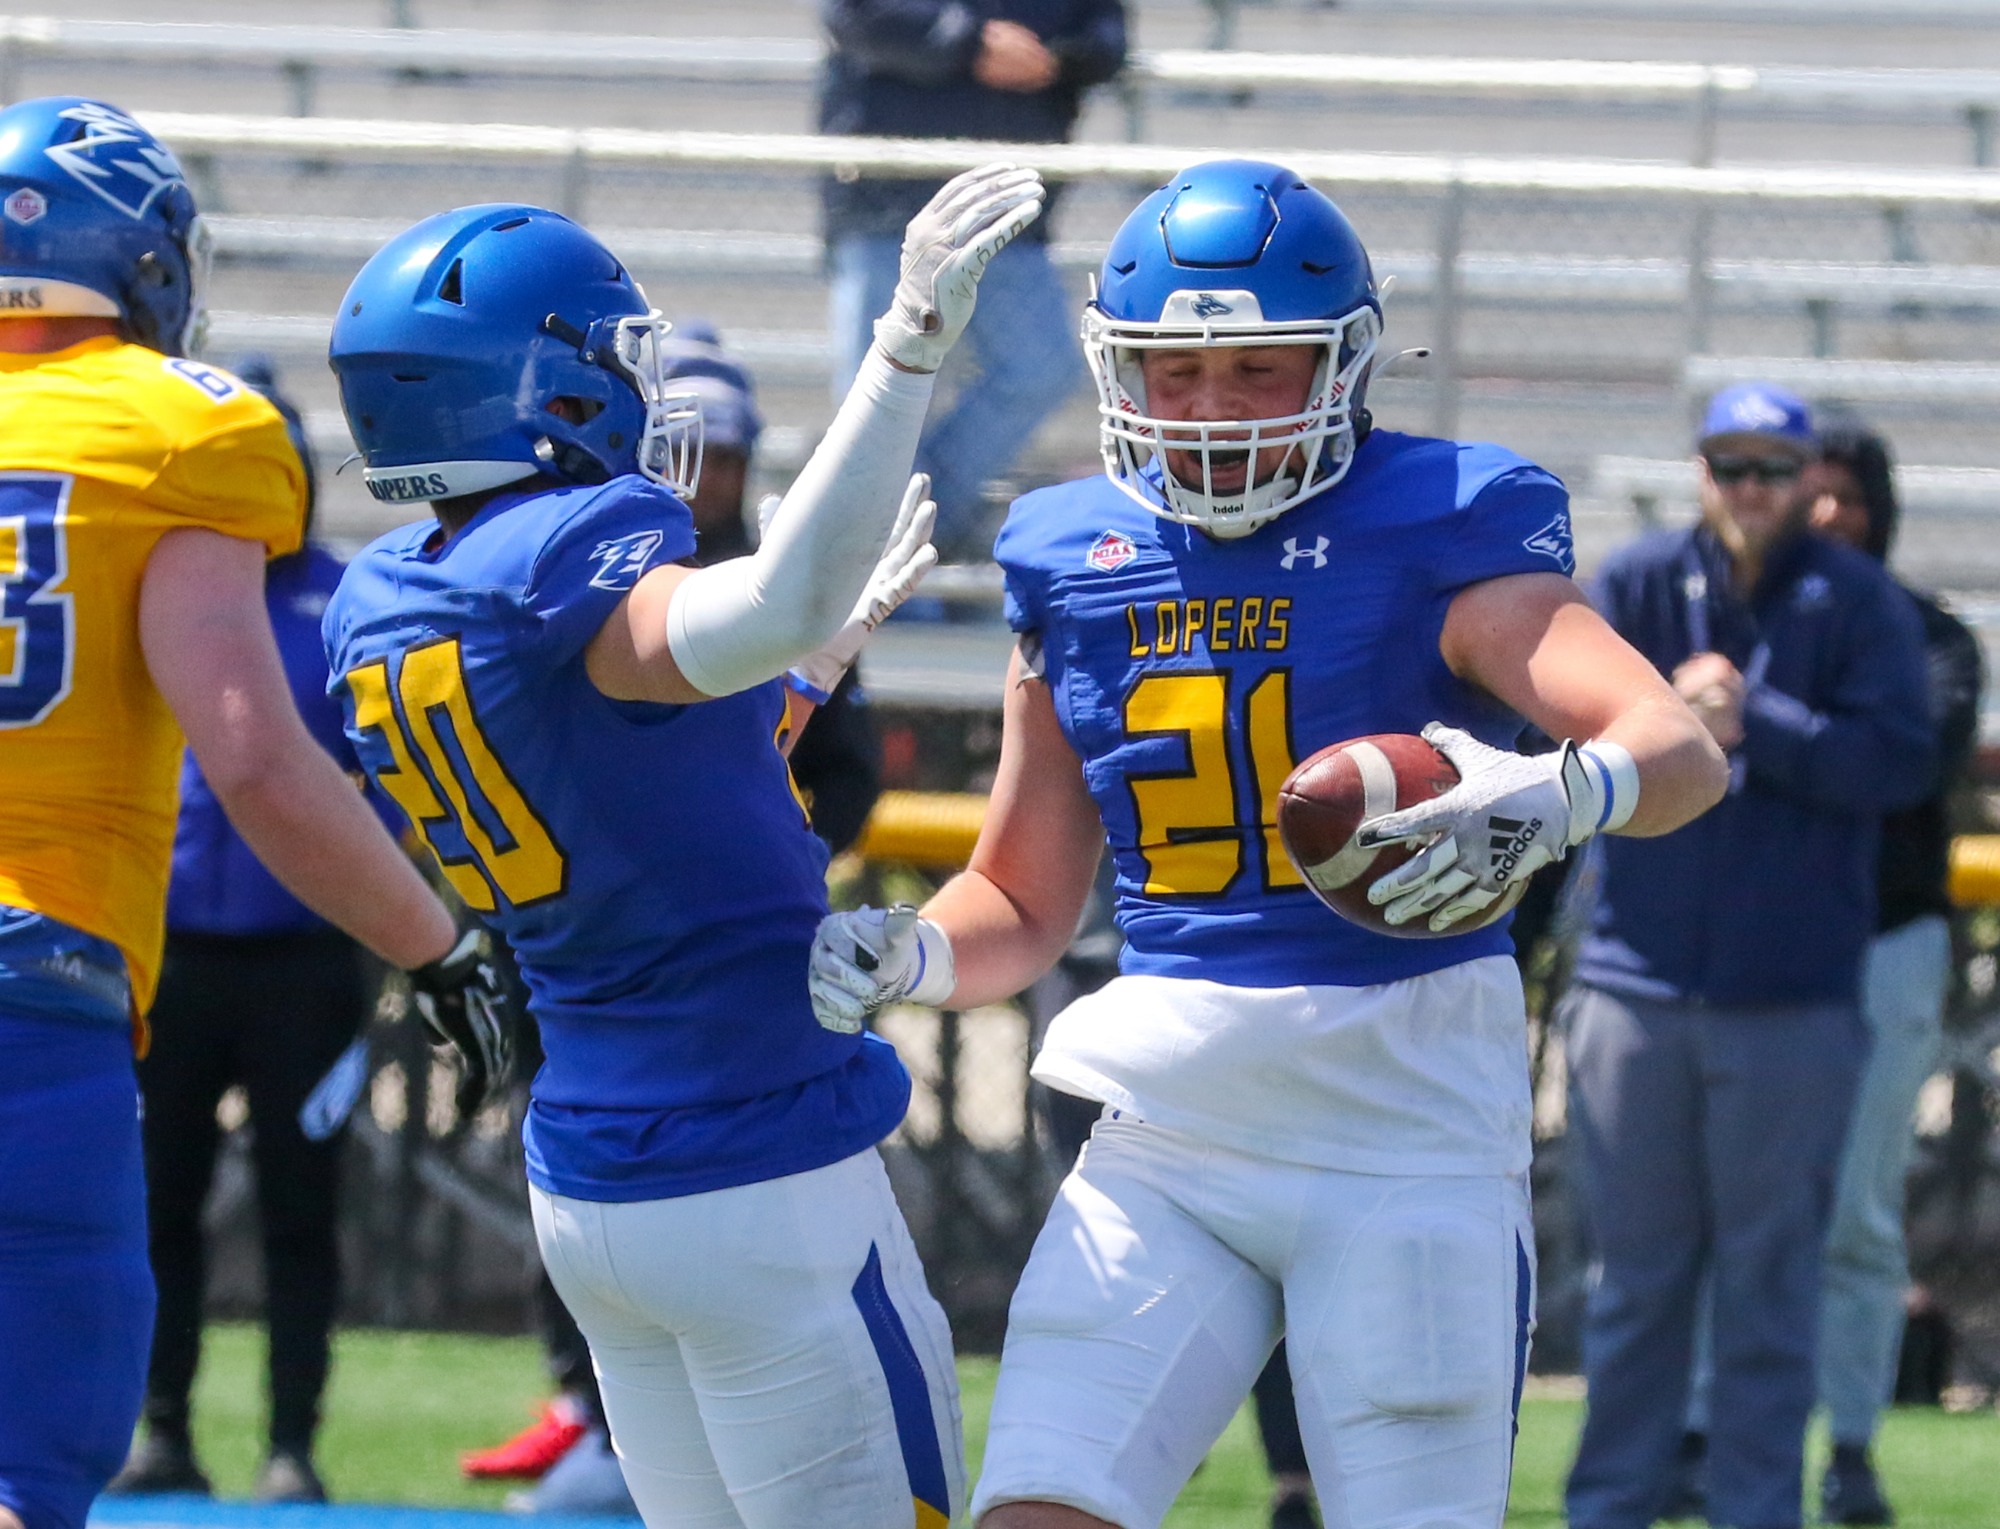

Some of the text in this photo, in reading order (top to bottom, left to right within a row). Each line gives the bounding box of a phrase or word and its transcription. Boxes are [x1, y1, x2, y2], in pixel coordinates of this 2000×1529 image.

[1126, 598, 1292, 656] LOPERS
[345, 632, 571, 914] 20
[1122, 666, 1308, 898] 21
[1494, 817, 1543, 881] adidas
